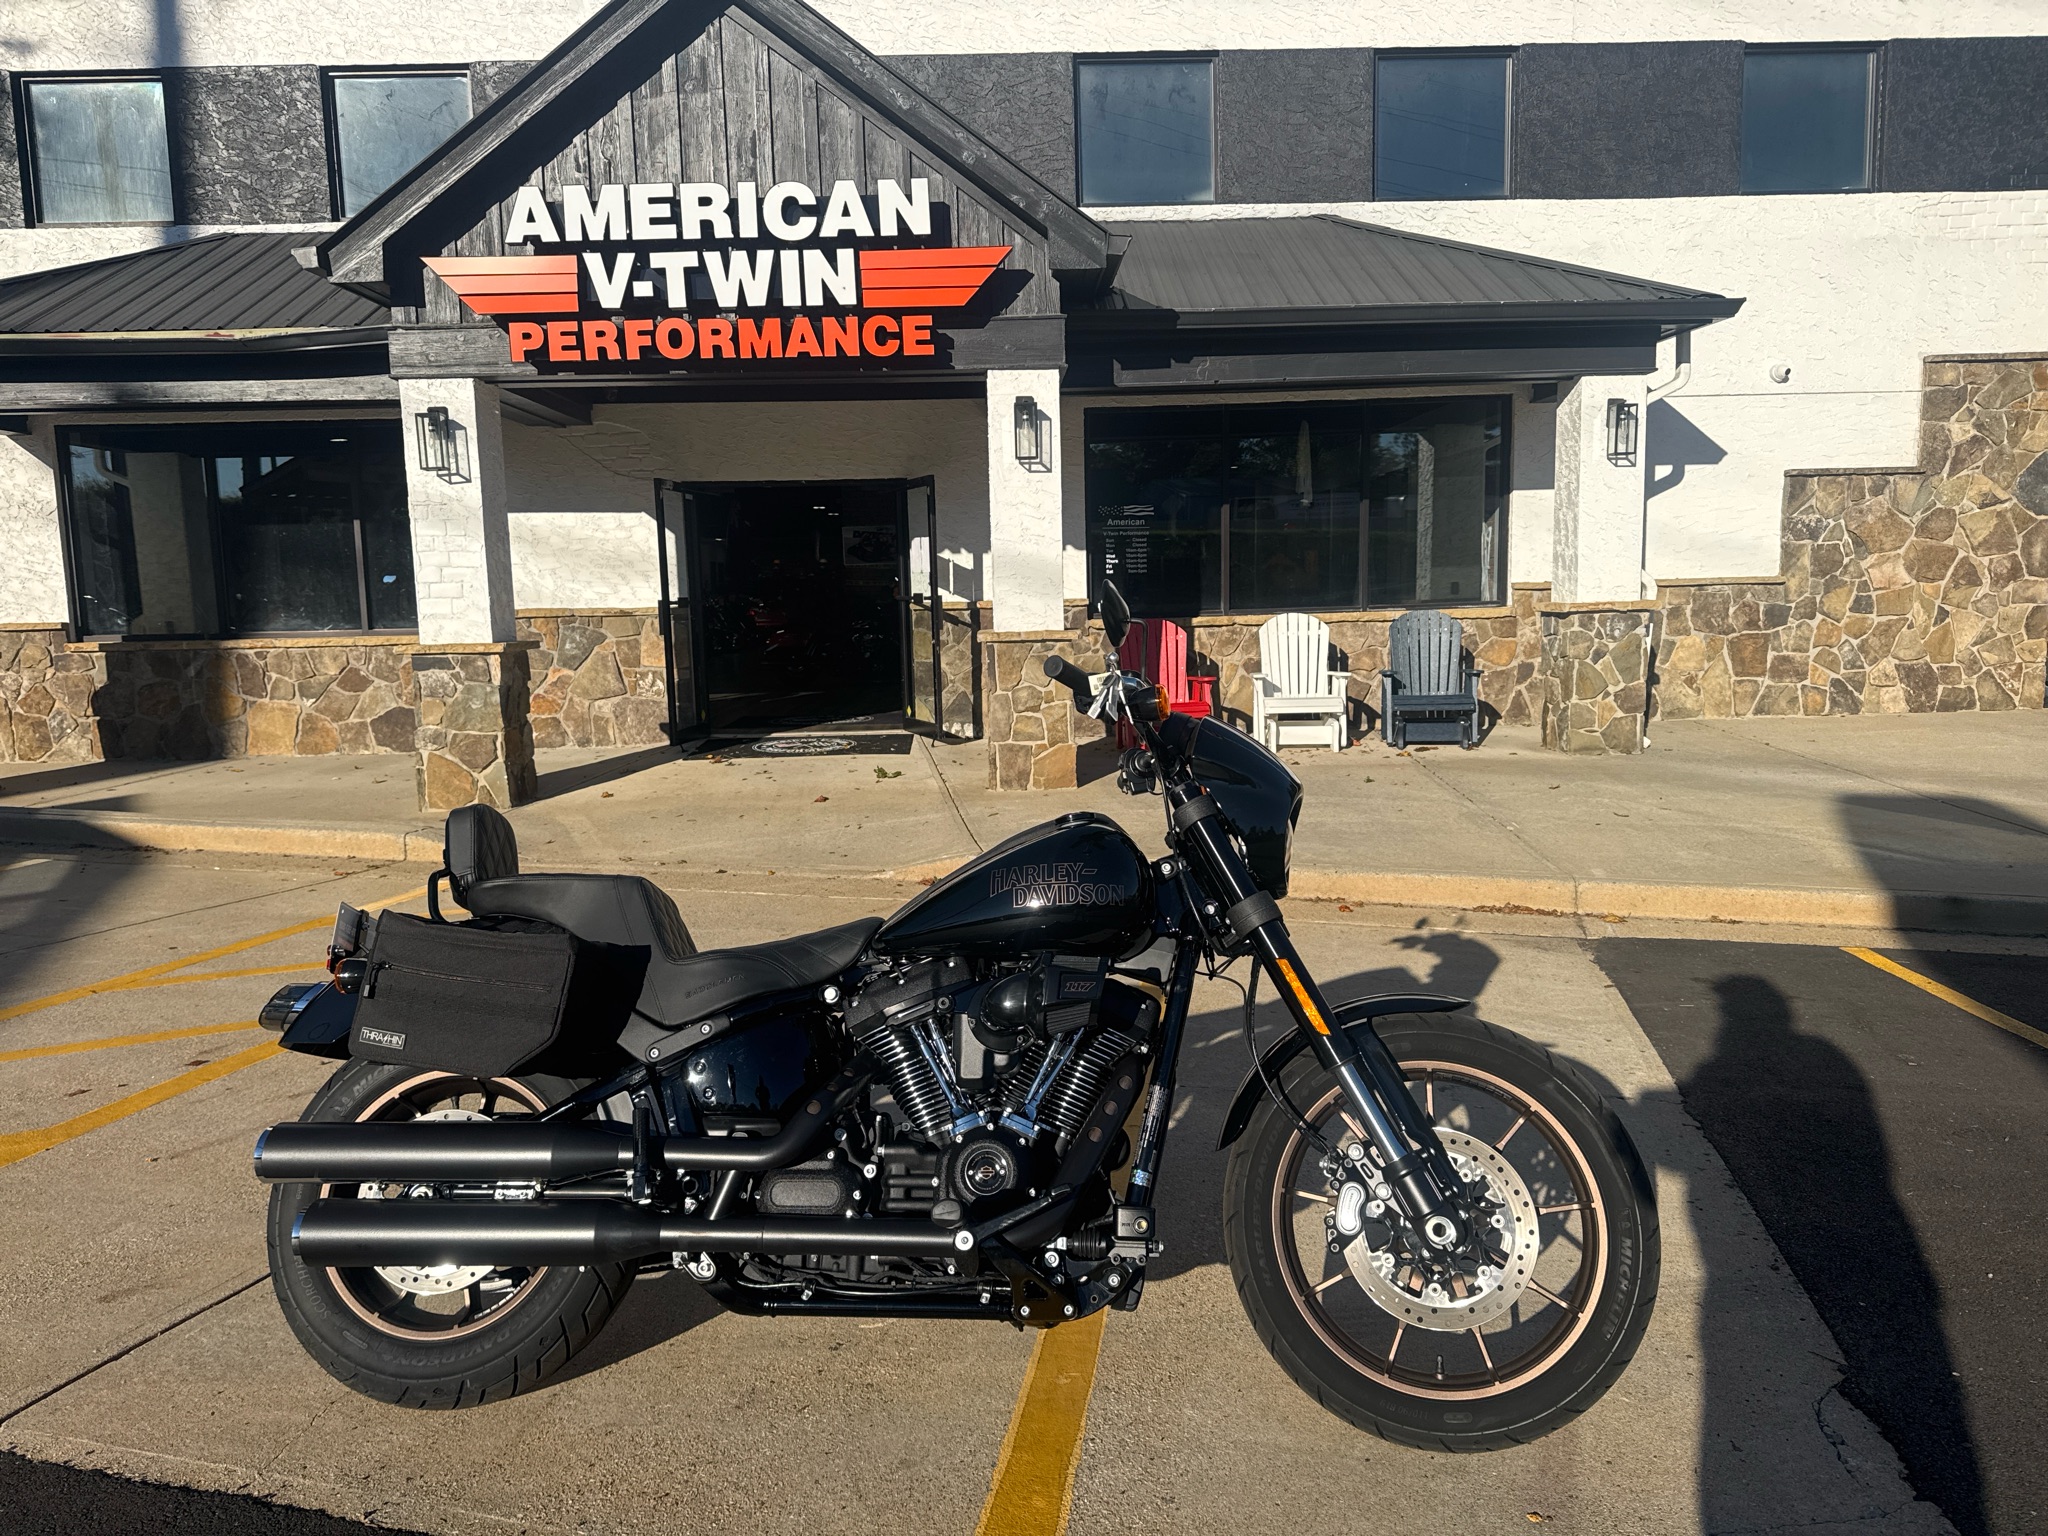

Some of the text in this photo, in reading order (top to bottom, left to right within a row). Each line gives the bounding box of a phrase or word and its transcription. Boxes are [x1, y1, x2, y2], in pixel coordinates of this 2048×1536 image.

[505, 178, 932, 245] AMERICAN
[582, 247, 858, 309] V-TWIN
[508, 315, 935, 363] PERFORMANCE
[989, 862, 1098, 897] HARLEY-
[1012, 883, 1125, 908] DAVIDSON
[1064, 981, 1097, 992] 117
[1602, 1238, 1633, 1341] MICHELIN
